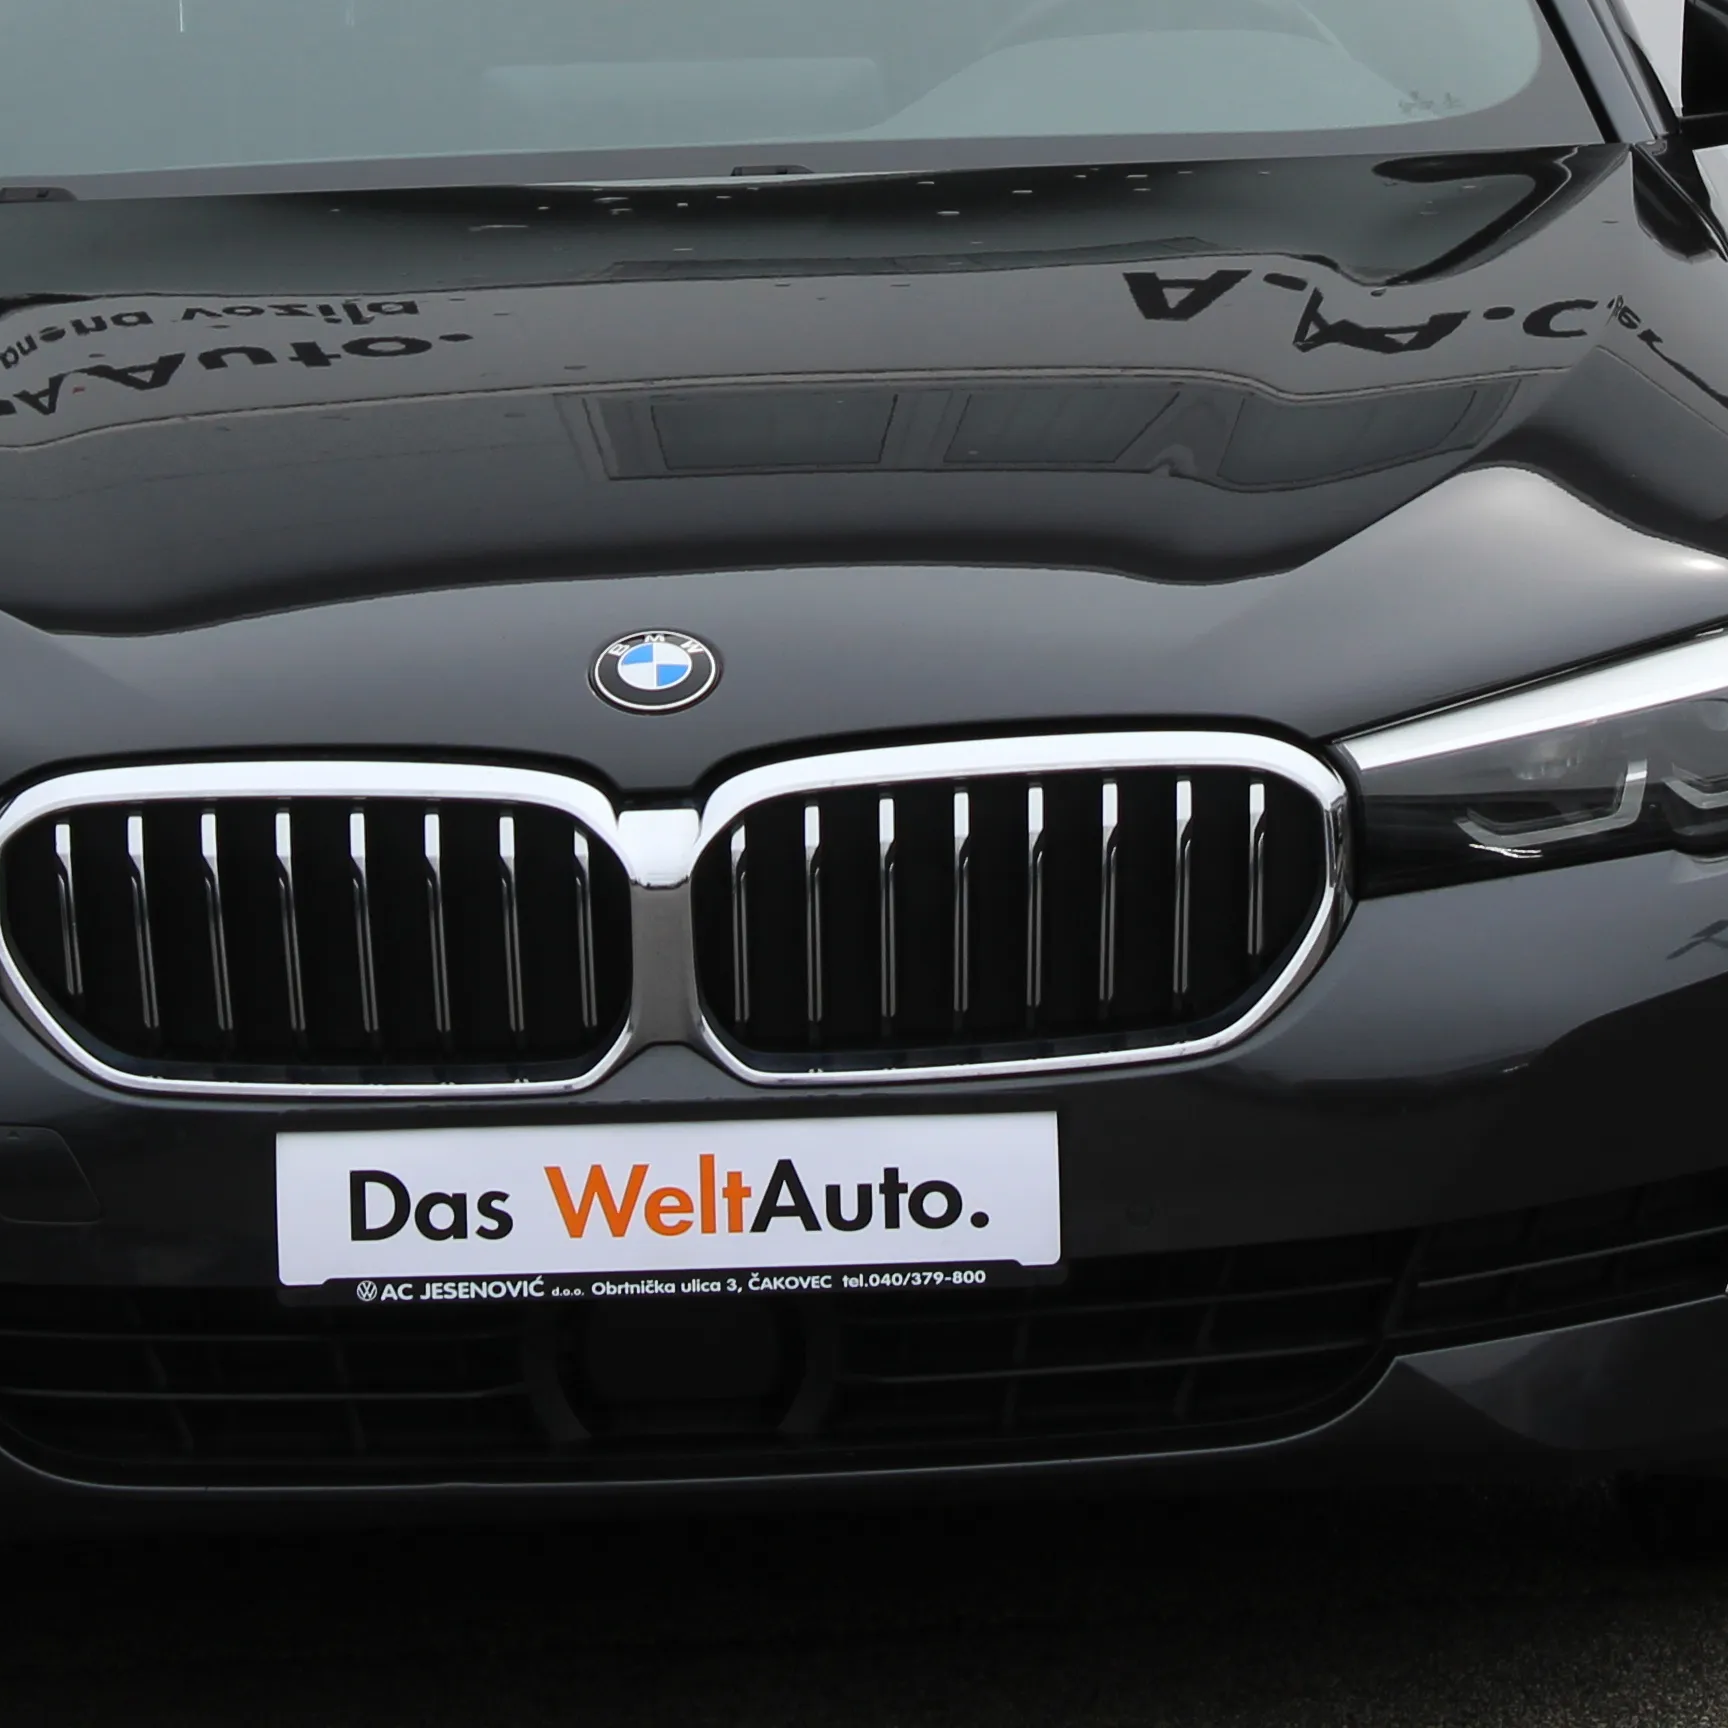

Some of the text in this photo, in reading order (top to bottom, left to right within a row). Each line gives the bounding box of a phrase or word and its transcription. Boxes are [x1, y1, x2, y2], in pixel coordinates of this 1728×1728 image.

[608, 634, 705, 657] BMW
[349, 1154, 990, 1242] Das WeltAuto.
[380, 1283, 414, 1301] AC
[419, 1275, 545, 1300] JESENOVIĆ
[551, 1286, 585, 1297] d.o.o.
[591, 1280, 676, 1296] Obrtnička
[680, 1278, 722, 1293] ulica
[726, 1278, 743, 1294] 3,
[747, 1272, 833, 1291] ČAKOVEC
[842, 1269, 987, 1289] tel.040/379-800
